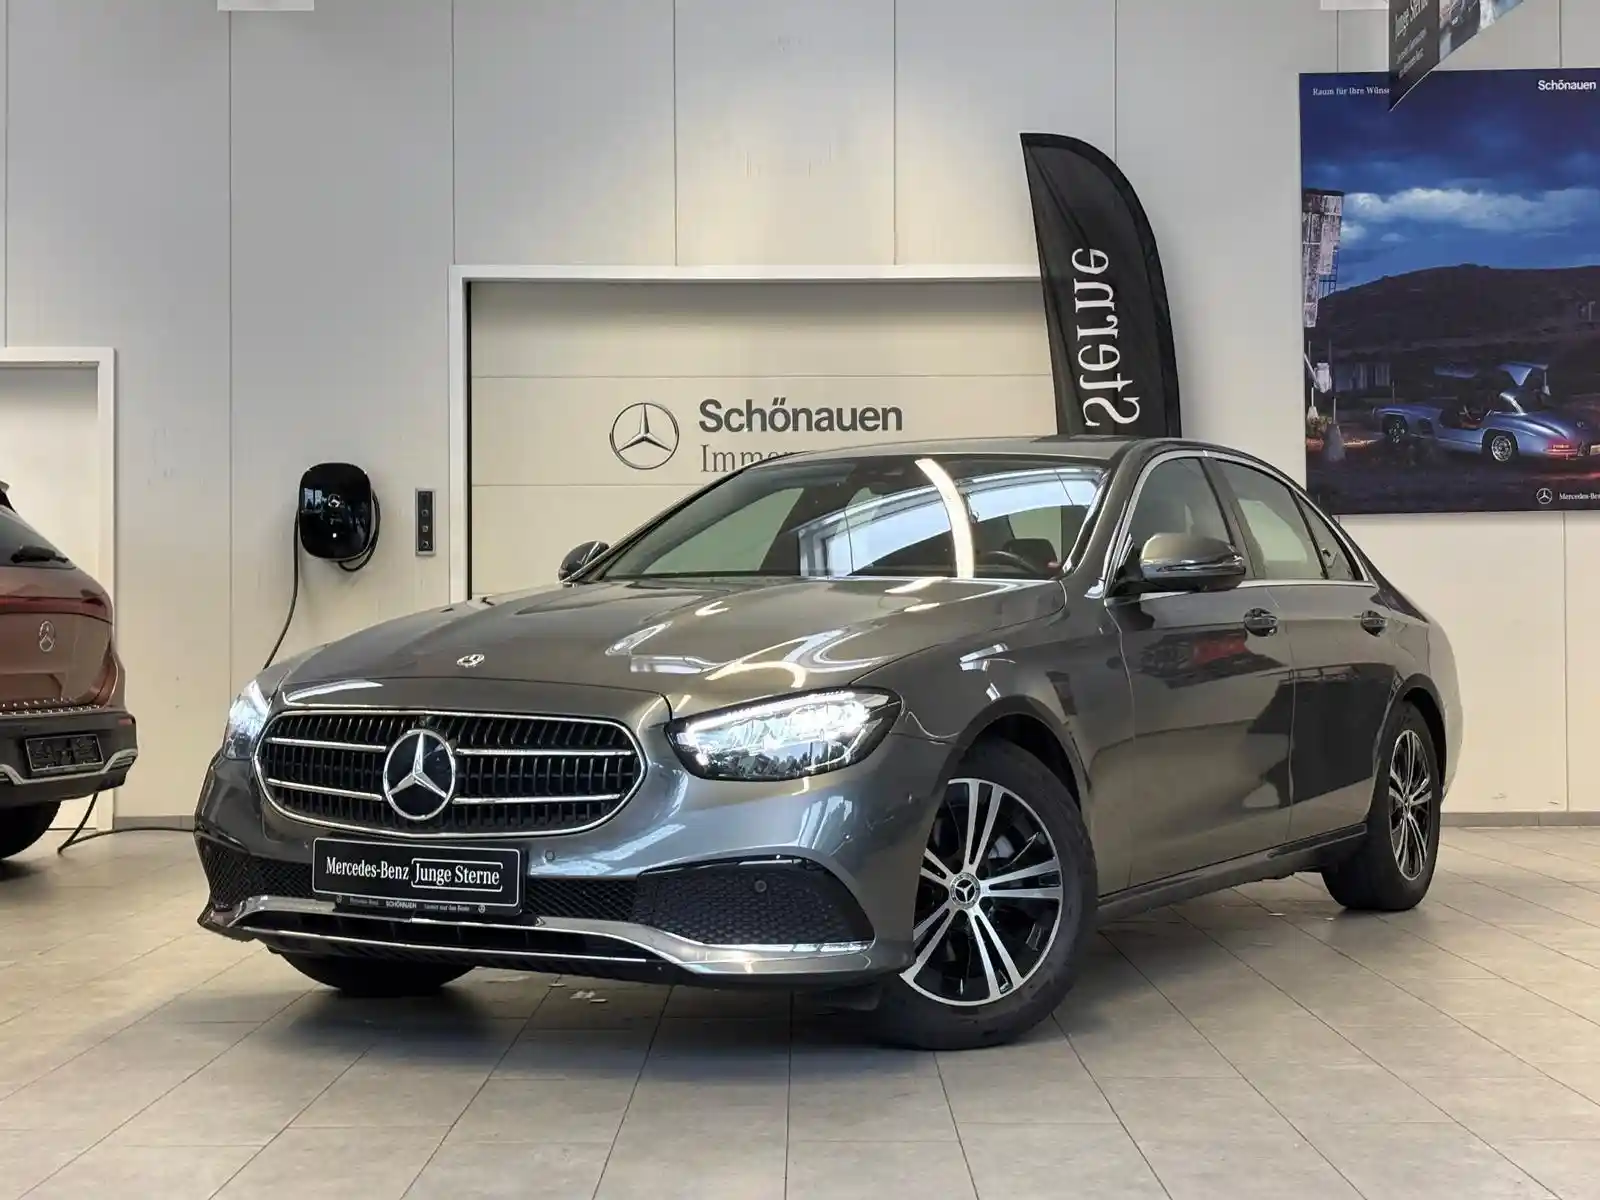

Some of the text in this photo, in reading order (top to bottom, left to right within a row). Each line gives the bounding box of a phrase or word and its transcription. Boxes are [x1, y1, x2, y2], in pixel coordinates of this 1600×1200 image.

[1312, 88, 1334, 96] Raum
[1336, 87, 1347, 96] für
[1349, 86, 1364, 95] Ihre
[1537, 79, 1597, 91] Schönauen
[699, 397, 903, 432] Schönauen
[700, 443, 796, 473] Imm
[1559, 492, 1600, 501] Mercedes-Be
[325, 856, 500, 886] Mercedes-Benz Junge Sterne
